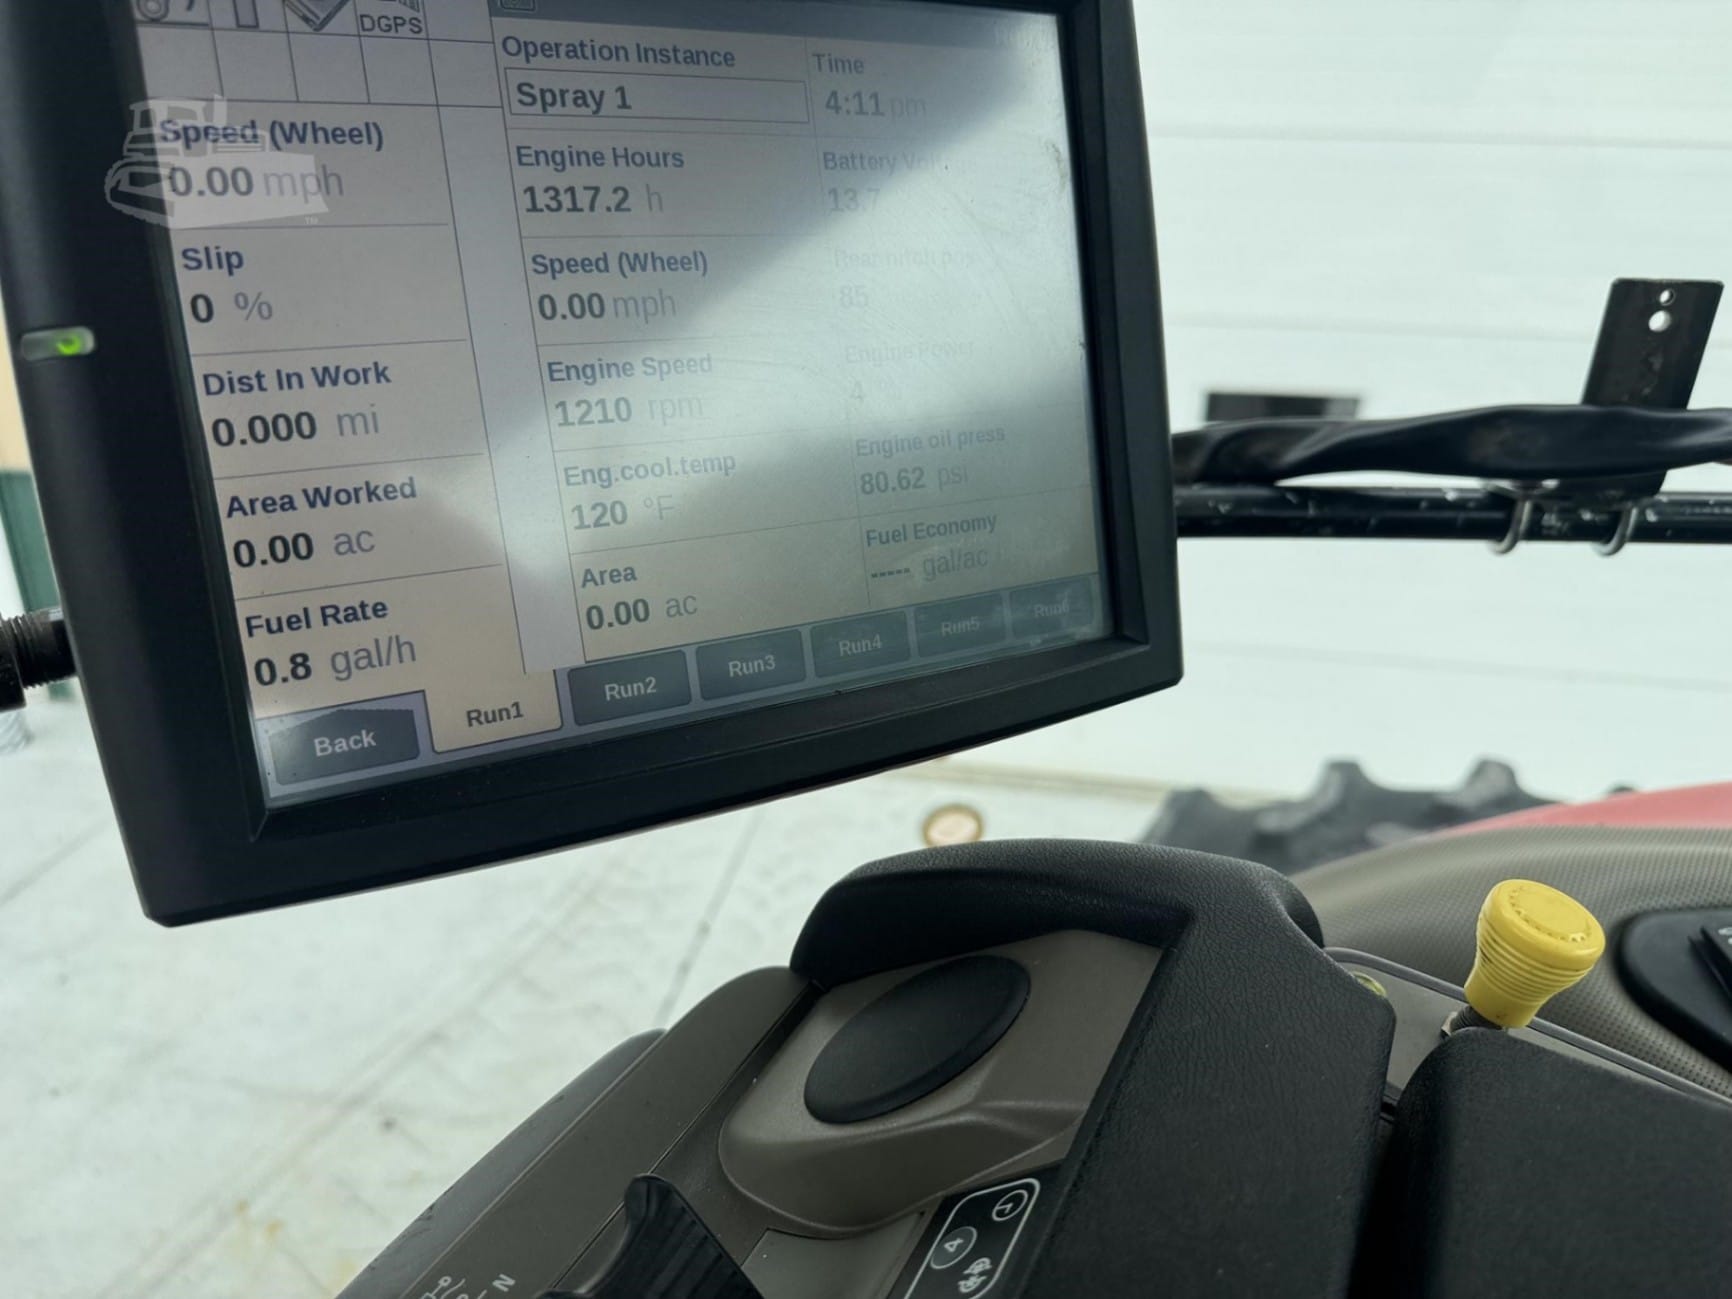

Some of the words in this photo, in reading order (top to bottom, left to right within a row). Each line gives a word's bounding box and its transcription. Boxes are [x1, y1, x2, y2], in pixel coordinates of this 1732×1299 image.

[360, 14, 423, 34] DGPS
[502, 36, 629, 64] Operation
[636, 43, 736, 67] Instance
[812, 53, 864, 74] Time
[516, 82, 605, 115] Spray
[615, 85, 632, 110] 1
[825, 90, 885, 117] 4:11
[160, 119, 260, 149] Speed
[270, 120, 384, 152] (Wheel)
[516, 145, 605, 173] Engine
[612, 147, 685, 169] Hours
[823, 151, 897, 176] Battery
[169, 165, 253, 197] 0.00
[264, 165, 344, 203] mph
[523, 186, 632, 213] 1317.2
[646, 184, 663, 212] h
[182, 246, 244, 276] Slip
[532, 252, 610, 280] Speed
[618, 251, 708, 278] (Wheel)
[190, 294, 214, 323] 0
[235, 291, 273, 321] %
[537, 292, 605, 321] 0.00
[613, 288, 677, 324] mph
[203, 371, 267, 395] Dist
[276, 369, 304, 390] In
[311, 361, 392, 387] Work
[547, 359, 635, 385] Engine
[641, 354, 713, 381] Speed
[211, 411, 317, 447] 0.000
[337, 403, 379, 436] mi
[555, 397, 632, 427] 1210
[648, 398, 703, 425] rpm
[856, 434, 922, 459] Engine
[928, 430, 950, 449] oil
[958, 426, 1006, 450] press
[564, 456, 736, 489] Eng.cool.temp
[860, 467, 926, 495] 80.62
[937, 465, 968, 491] psi
[226, 494, 297, 519] Area
[302, 476, 416, 509] Worked
[571, 501, 628, 530] 120
[866, 525, 907, 547] Fuel
[914, 515, 997, 540] Economy
[233, 532, 313, 567] 0.00
[334, 530, 376, 555] ac
[580, 566, 637, 588] Area
[923, 548, 988, 581] gal/ac
[245, 607, 311, 637] Fuel
[320, 601, 389, 626] Rate
[586, 599, 650, 630] 0.00
[665, 595, 697, 618] ac
[941, 616, 981, 636] Run5
[839, 634, 882, 656] Run4
[254, 652, 312, 686] 0.8
[330, 635, 416, 681] gal/h
[728, 655, 776, 677] Run3
[604, 677, 656, 701] Run2
[466, 702, 523, 727] Run1
[314, 730, 376, 757] Back
